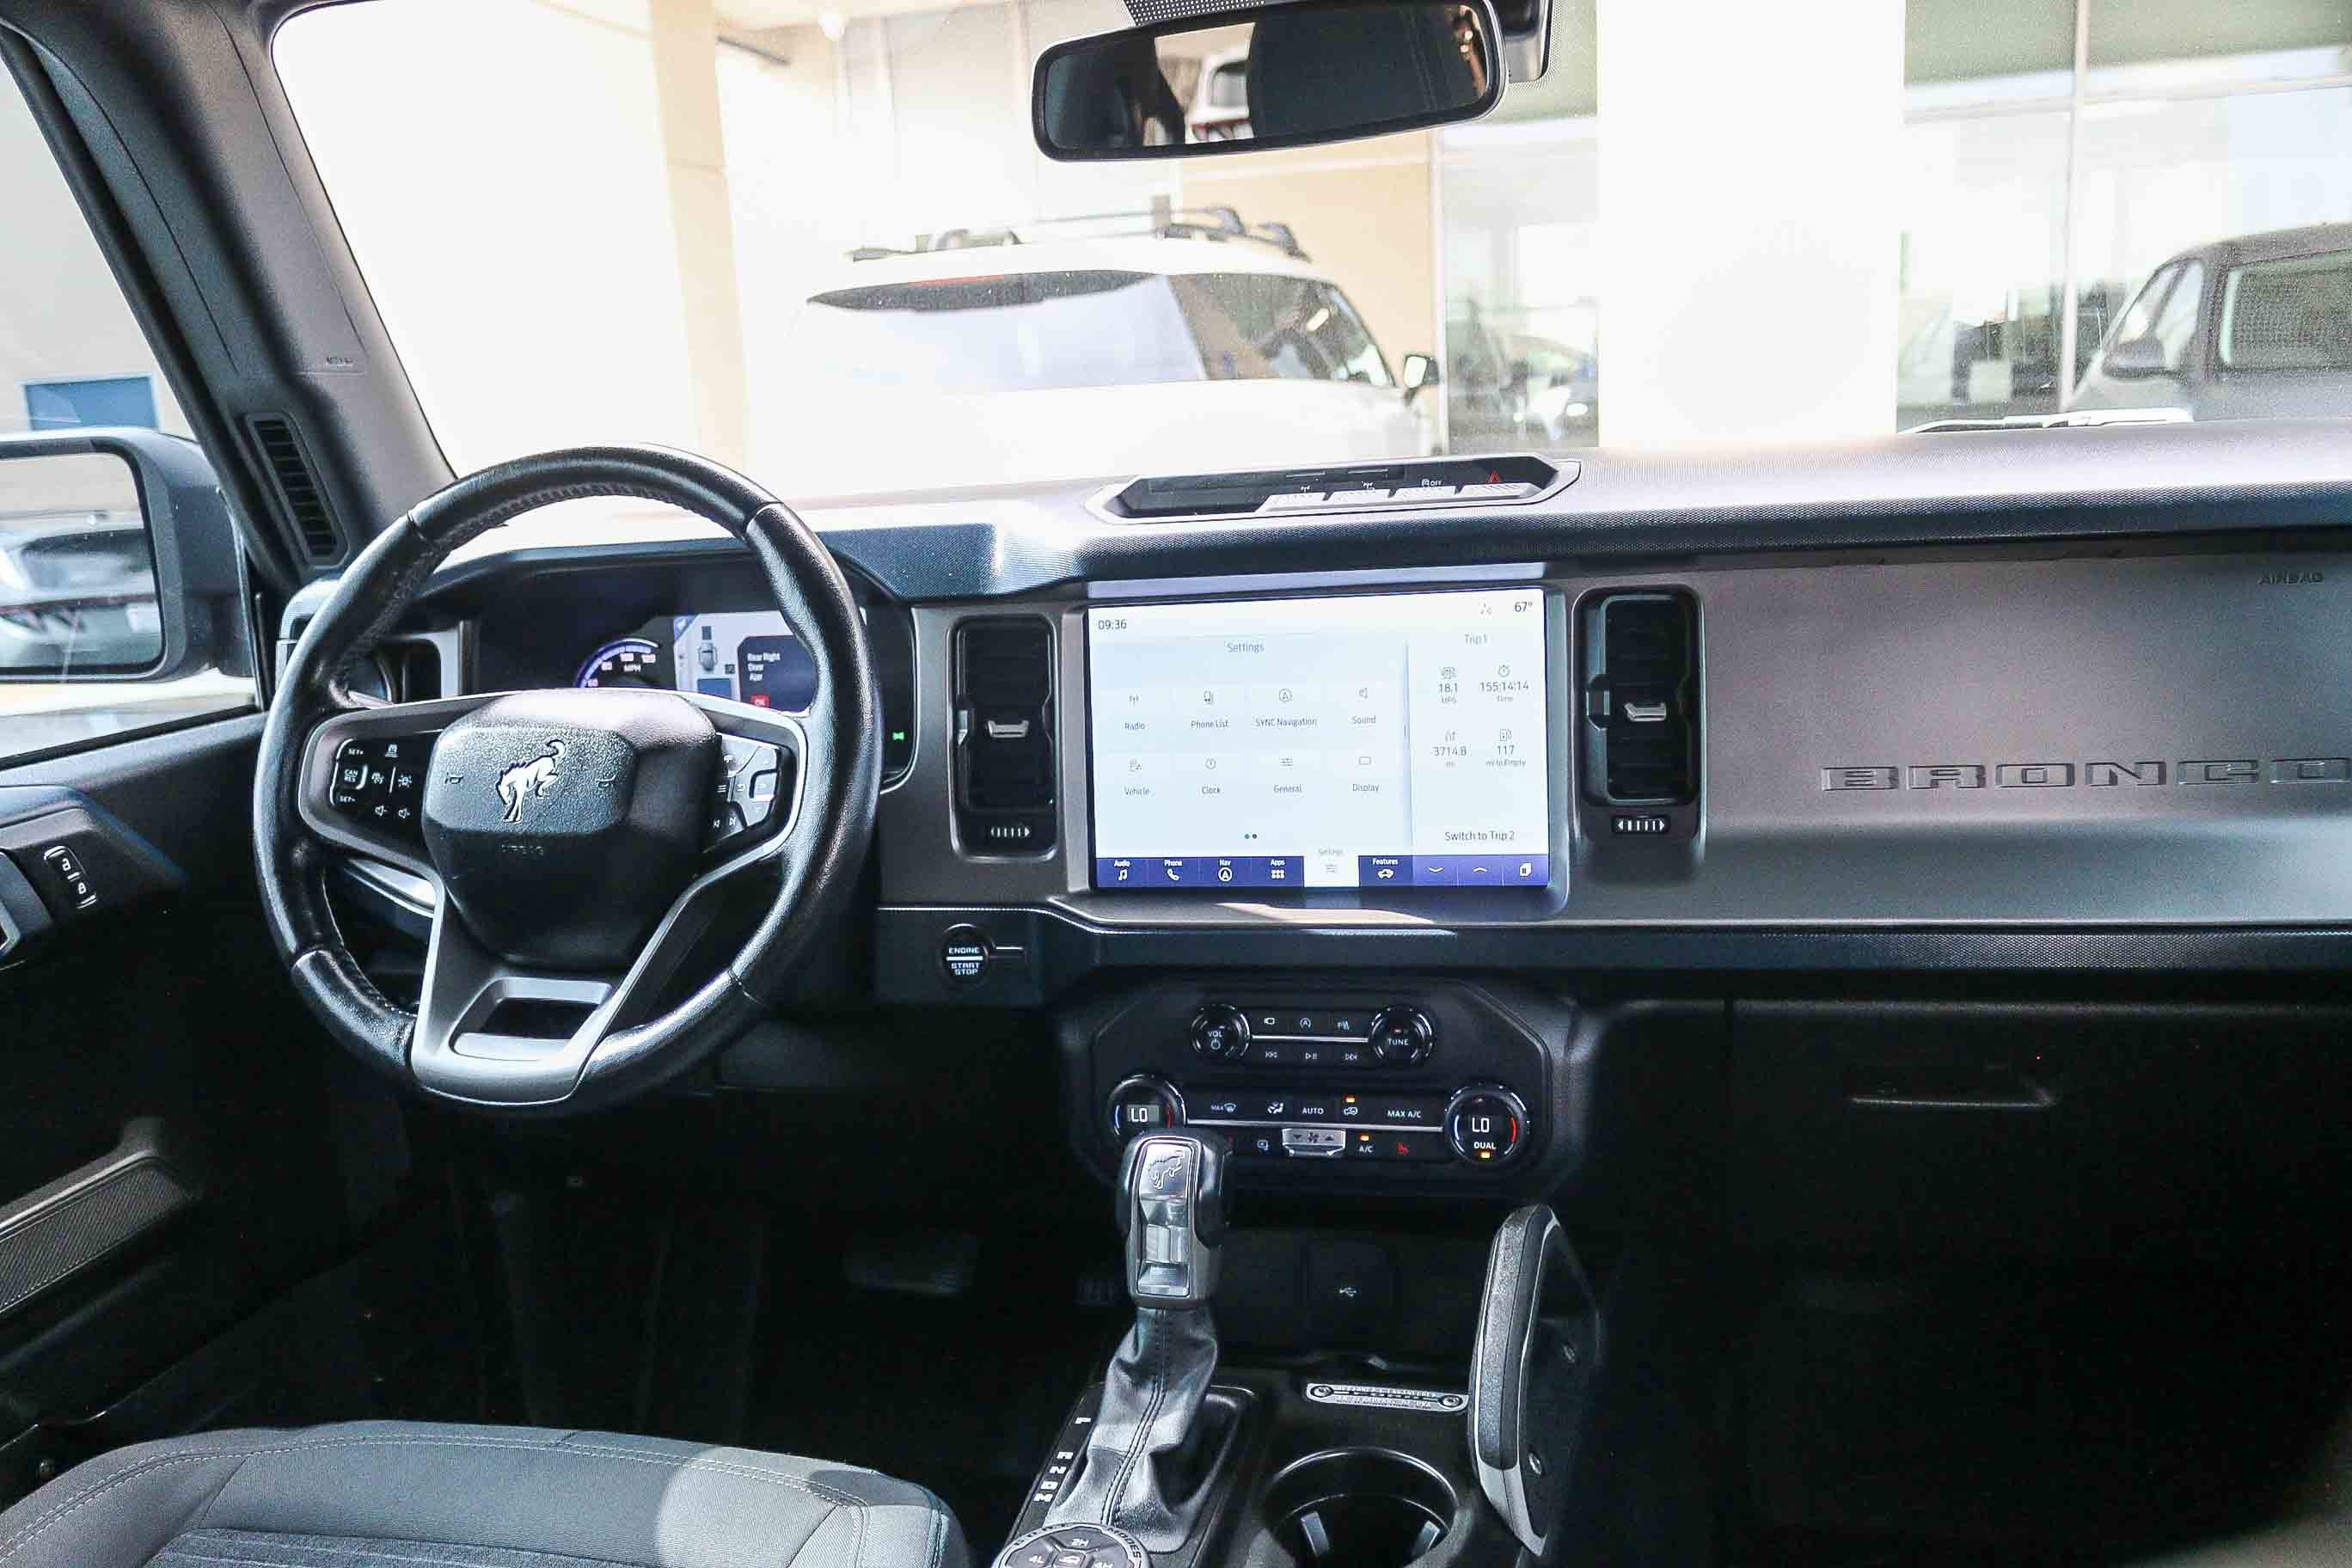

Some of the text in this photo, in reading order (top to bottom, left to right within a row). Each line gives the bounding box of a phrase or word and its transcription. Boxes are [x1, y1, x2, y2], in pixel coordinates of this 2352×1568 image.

[1098, 619, 1127, 631] 09:36
[1464, 634, 1482, 646] Trip
[1227, 641, 1265, 654] Settings
[1439, 683, 1458, 693] 18.1
[1479, 681, 1529, 691] 155:14:14
[1191, 719, 1229, 730] Phone List
[1277, 716, 1317, 728] Navigation
[1351, 715, 1376, 725] Sound
[1124, 721, 1146, 731] Radio
[1497, 745, 1516, 756] 117
[1821, 756, 2352, 791] BRONCO
[1124, 787, 1150, 796] Vehicle
[1202, 786, 1221, 794] Clock
[1273, 784, 1302, 793] General
[1352, 783, 1380, 794] Display
[1444, 830, 1516, 842] Switch to Trip 2
[1164, 859, 1183, 867] Phone
[1270, 859, 1285, 867] Apps
[1207, 1030, 1223, 1038] VOL
[1130, 1107, 1148, 1124] LO
[1387, 1110, 1422, 1118] MAX A/C
[1472, 1117, 1490, 1133] LO
[1358, 1145, 1374, 1154] A/C
[1473, 1141, 1497, 1150] DUAL
[1057, 1451, 1074, 1460] R
[1049, 1466, 1067, 1474] N
[1040, 1480, 1059, 1490] D
[1033, 1492, 1054, 1503] M
[1071, 1538, 1089, 1547] 2H
[1028, 1554, 1045, 1564] 4L
